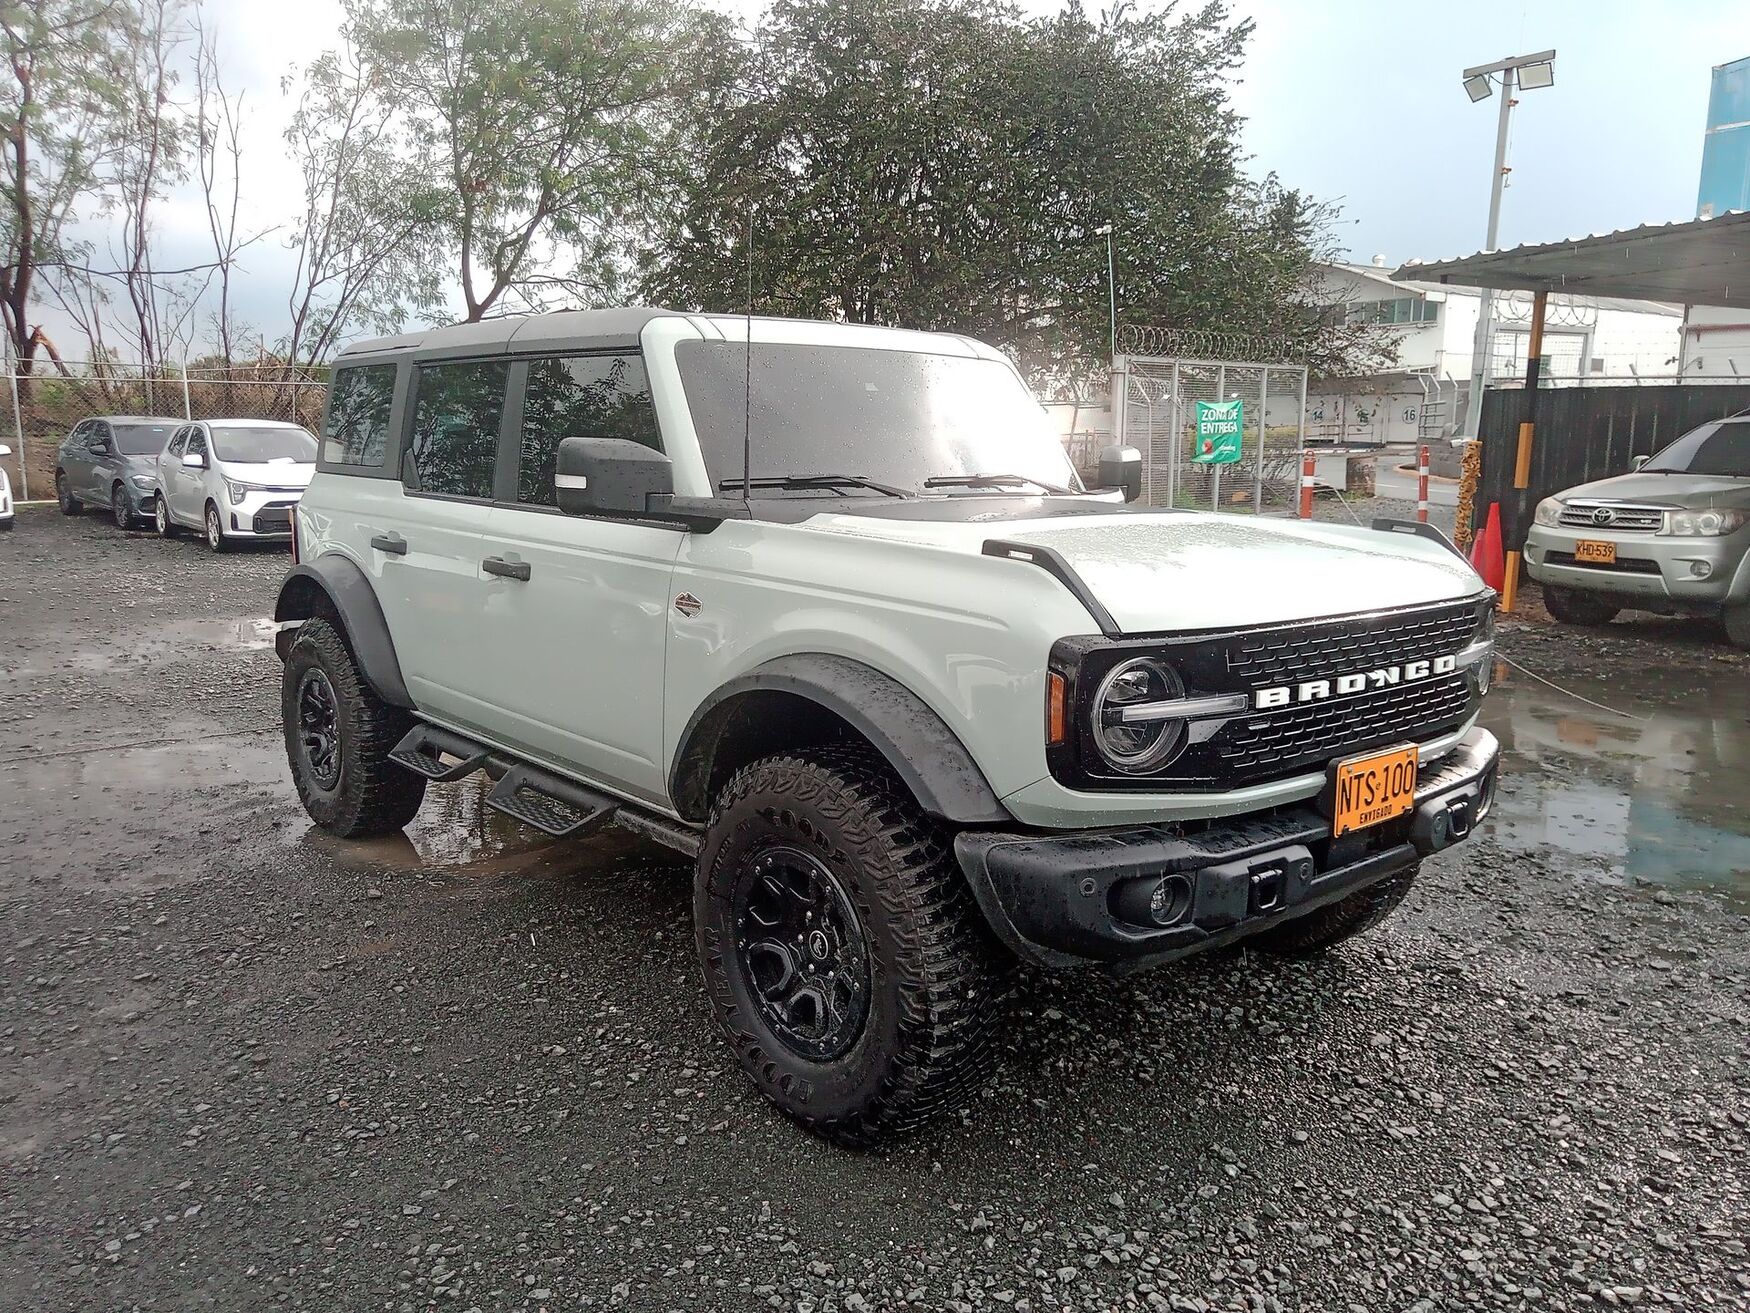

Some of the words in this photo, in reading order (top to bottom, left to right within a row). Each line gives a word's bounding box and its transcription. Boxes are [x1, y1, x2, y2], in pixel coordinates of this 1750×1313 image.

[1404, 409, 1415, 420] 16
[1201, 422, 1238, 433] ENTREGA
[1256, 655, 1456, 709] BRONCO
[1360, 804, 1392, 824] ENVIGADO
